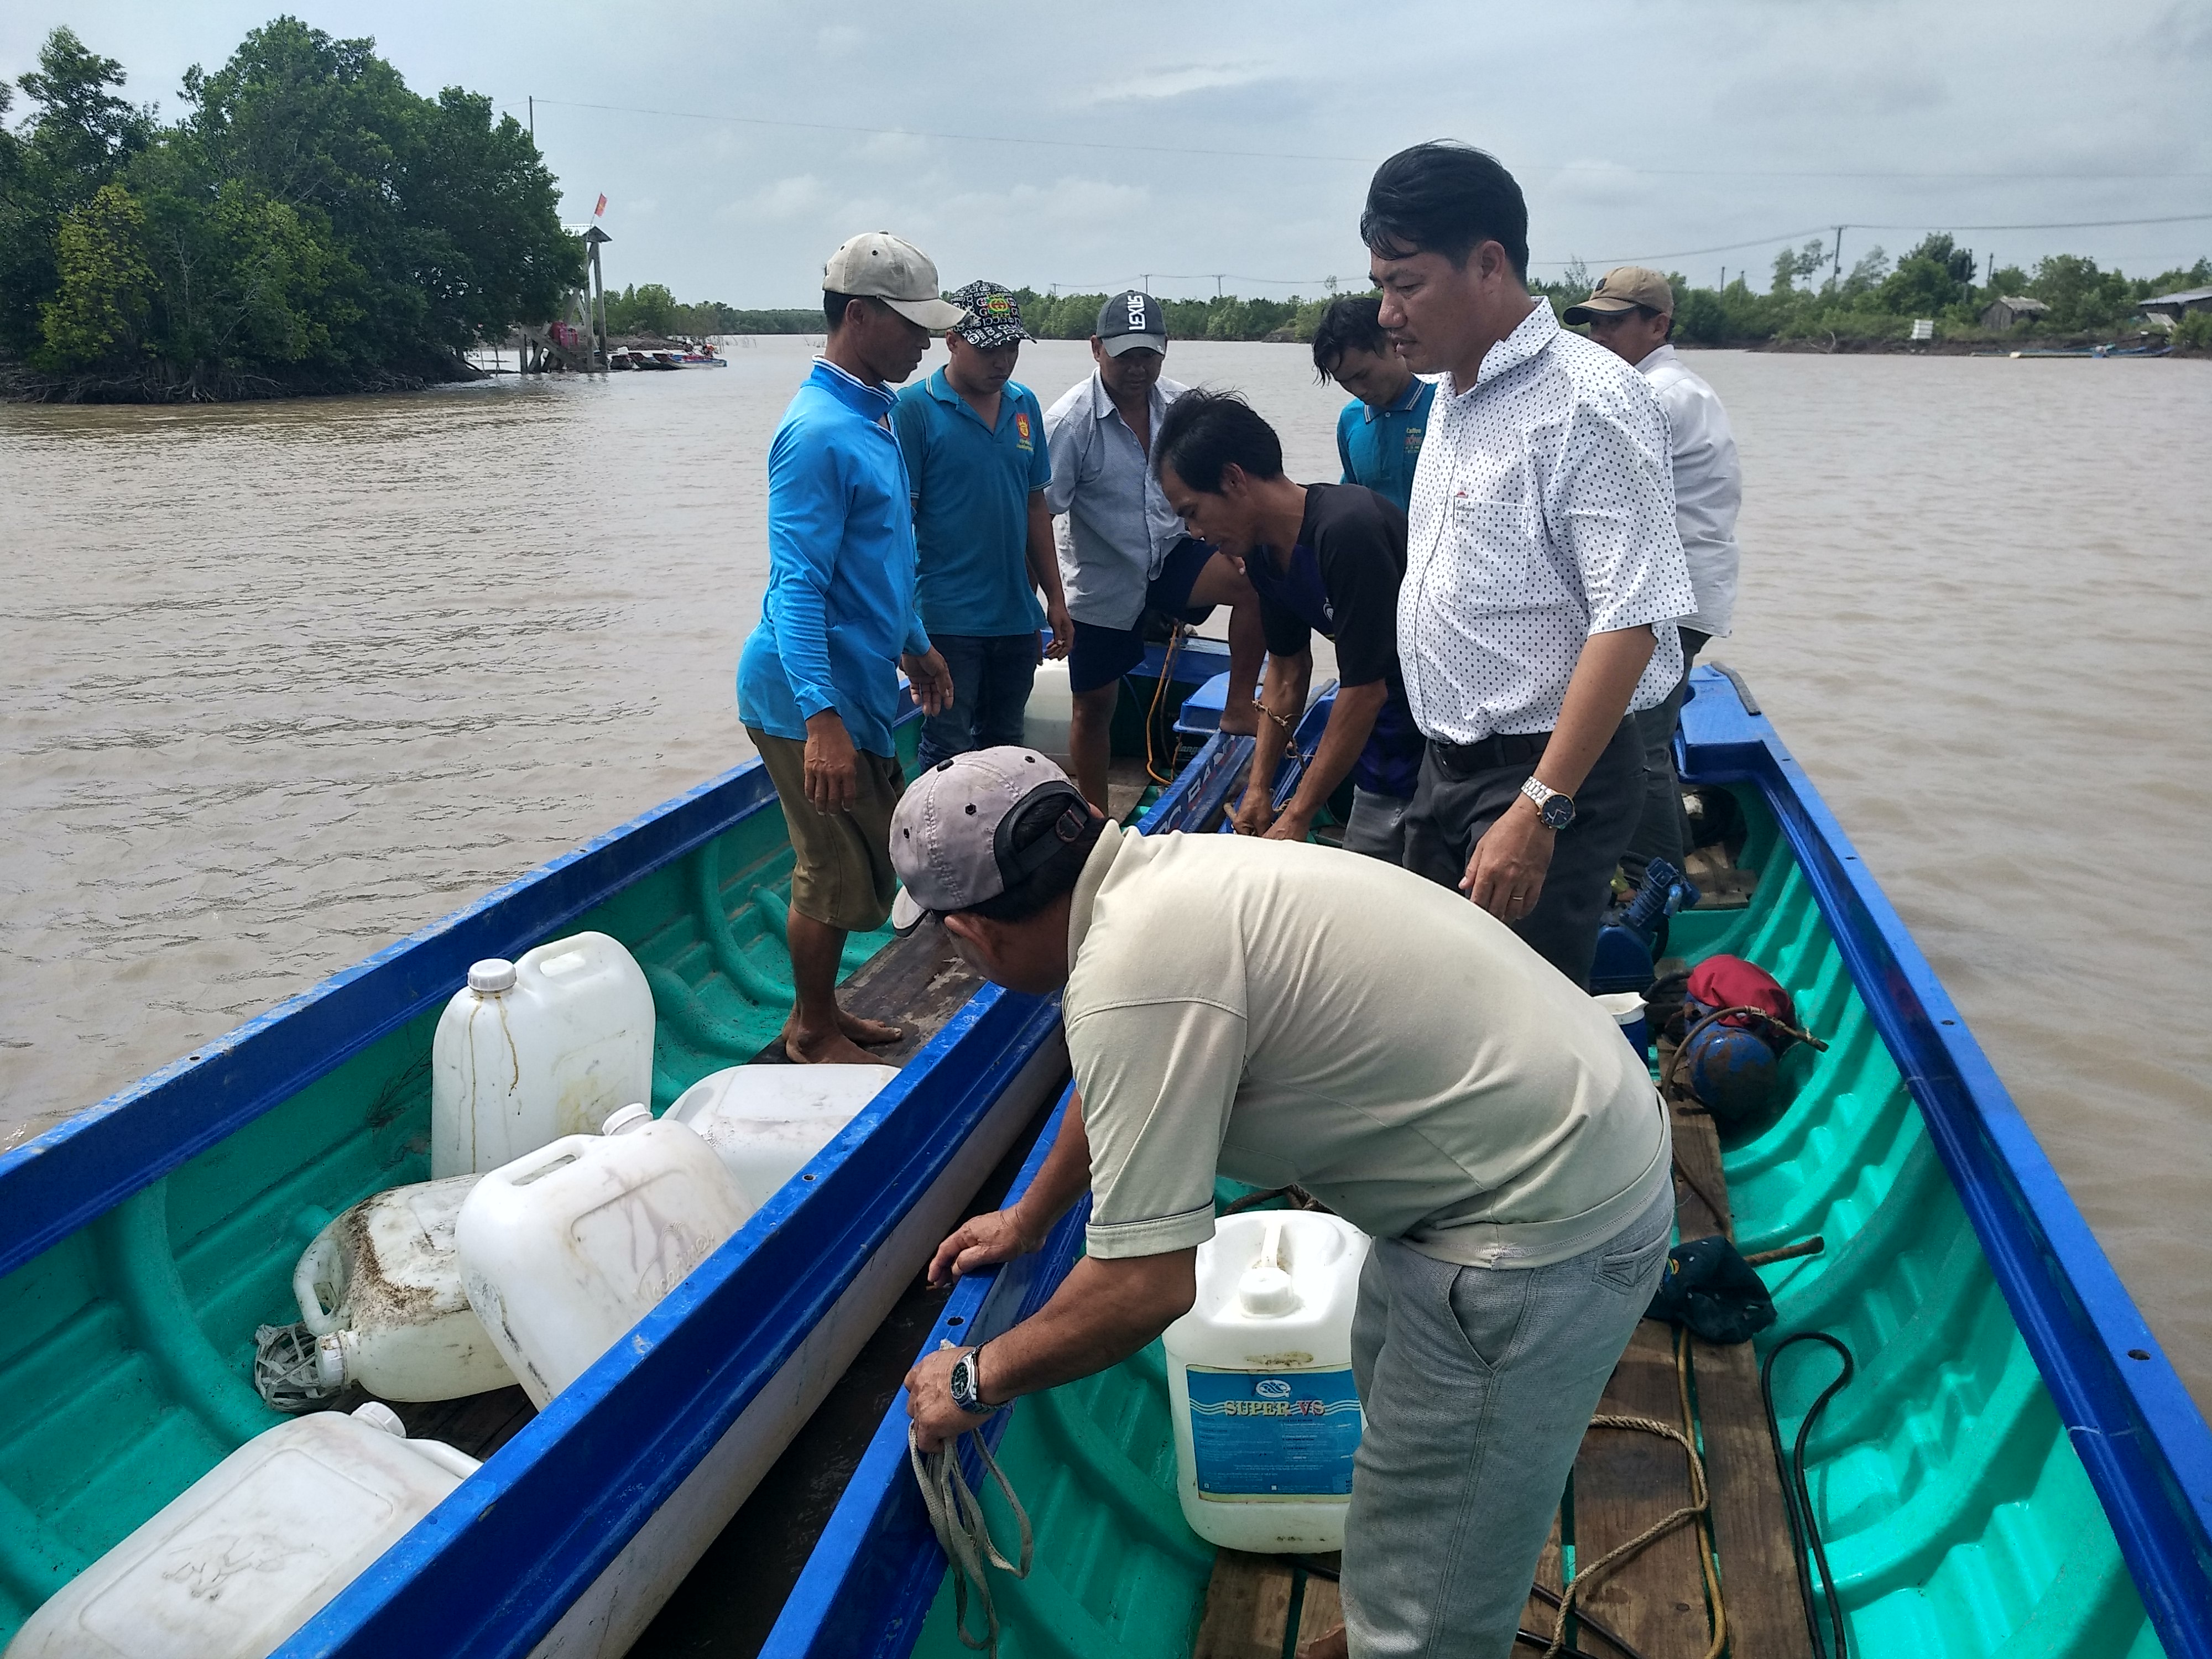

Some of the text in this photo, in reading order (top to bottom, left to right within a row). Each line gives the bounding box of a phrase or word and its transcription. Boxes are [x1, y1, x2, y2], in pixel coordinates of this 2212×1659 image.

[1127, 295, 1146, 331] LEXUS
[1224, 1400, 1326, 1416] SUPER VS
